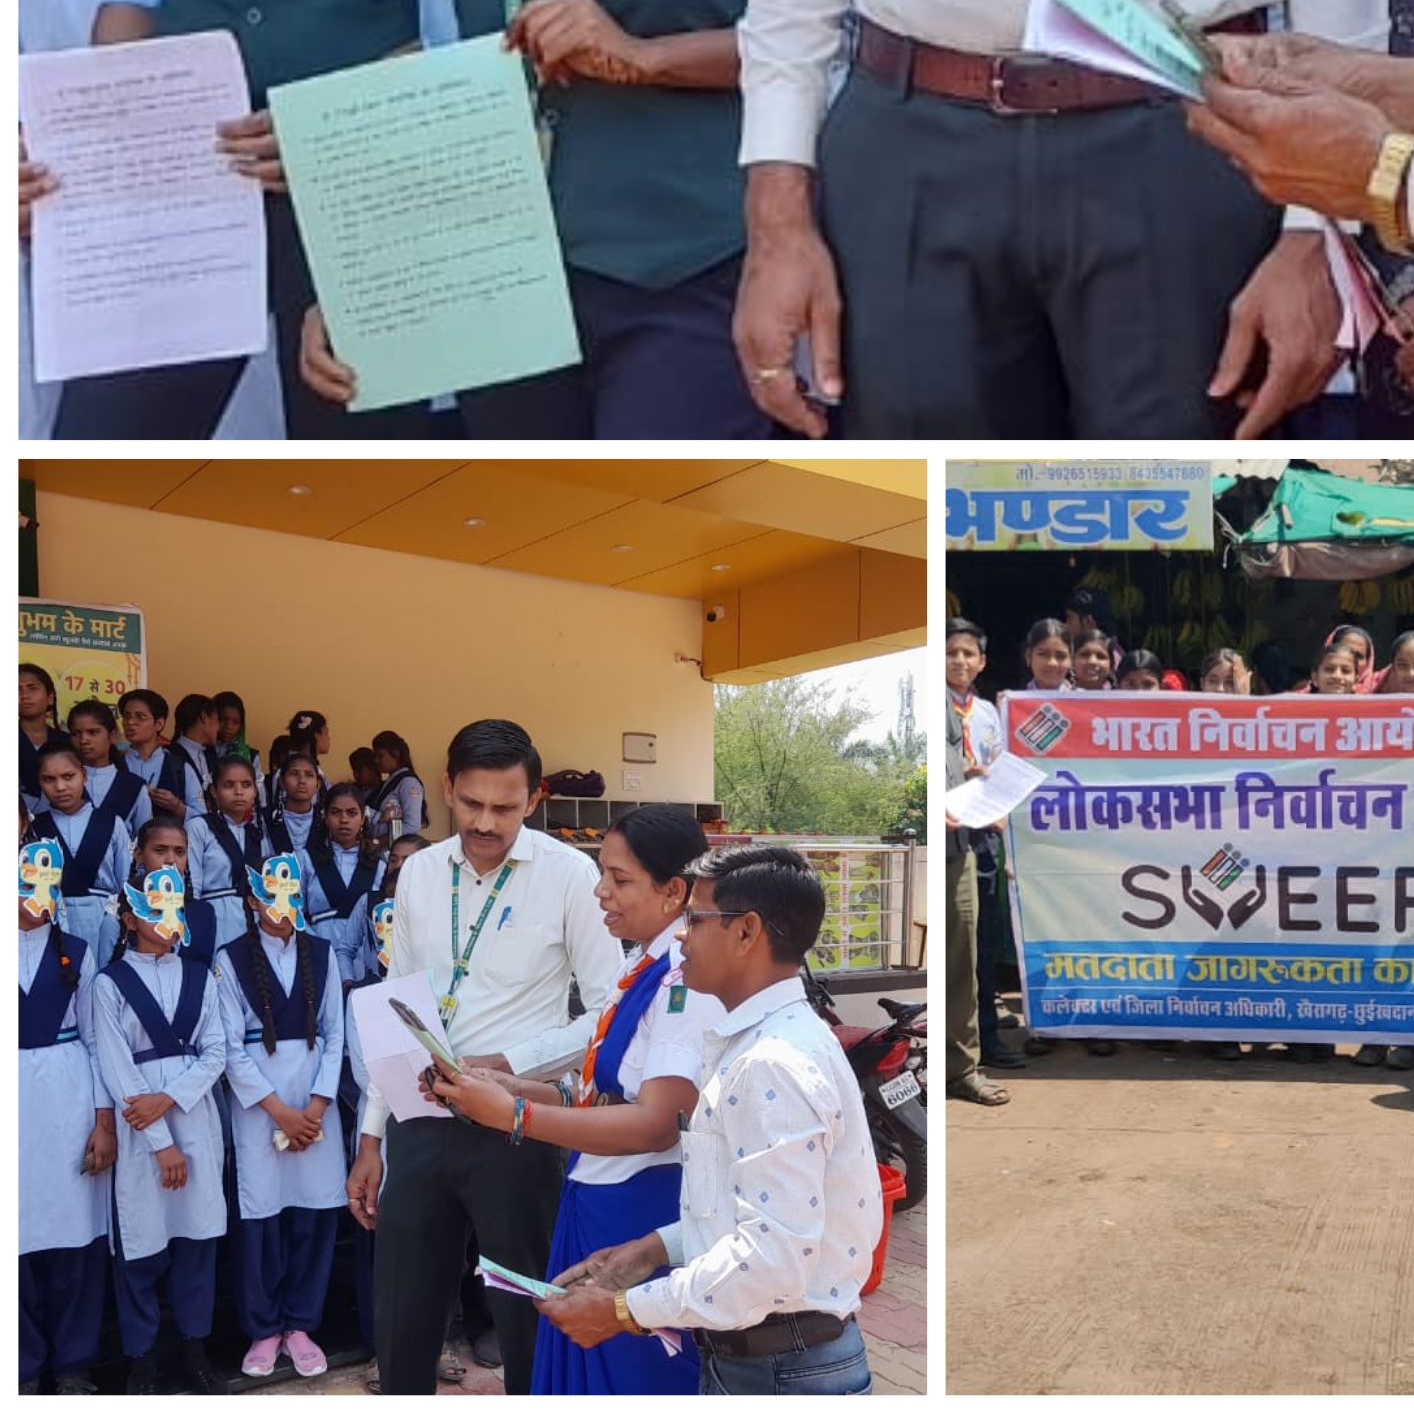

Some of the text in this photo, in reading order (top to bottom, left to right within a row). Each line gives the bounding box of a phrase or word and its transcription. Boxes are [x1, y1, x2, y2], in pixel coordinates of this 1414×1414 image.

[946, 489, 1190, 543] भण्डार
[62, 610, 84, 634] के
[89, 616, 127, 639] मार्ट
[65, 676, 125, 695] 17 से 30
[1091, 717, 1181, 751] भारत
[1187, 706, 1329, 751] निर्वाचन
[1031, 770, 1226, 830] लोकसभा
[1235, 768, 1408, 829] निर्वाचन
[1043, 952, 1176, 981] मतदाता
[1101, 995, 1123, 1014] एवं
[1125, 995, 1164, 1015] जिला
[1167, 995, 1222, 1015] निर्वाचन
